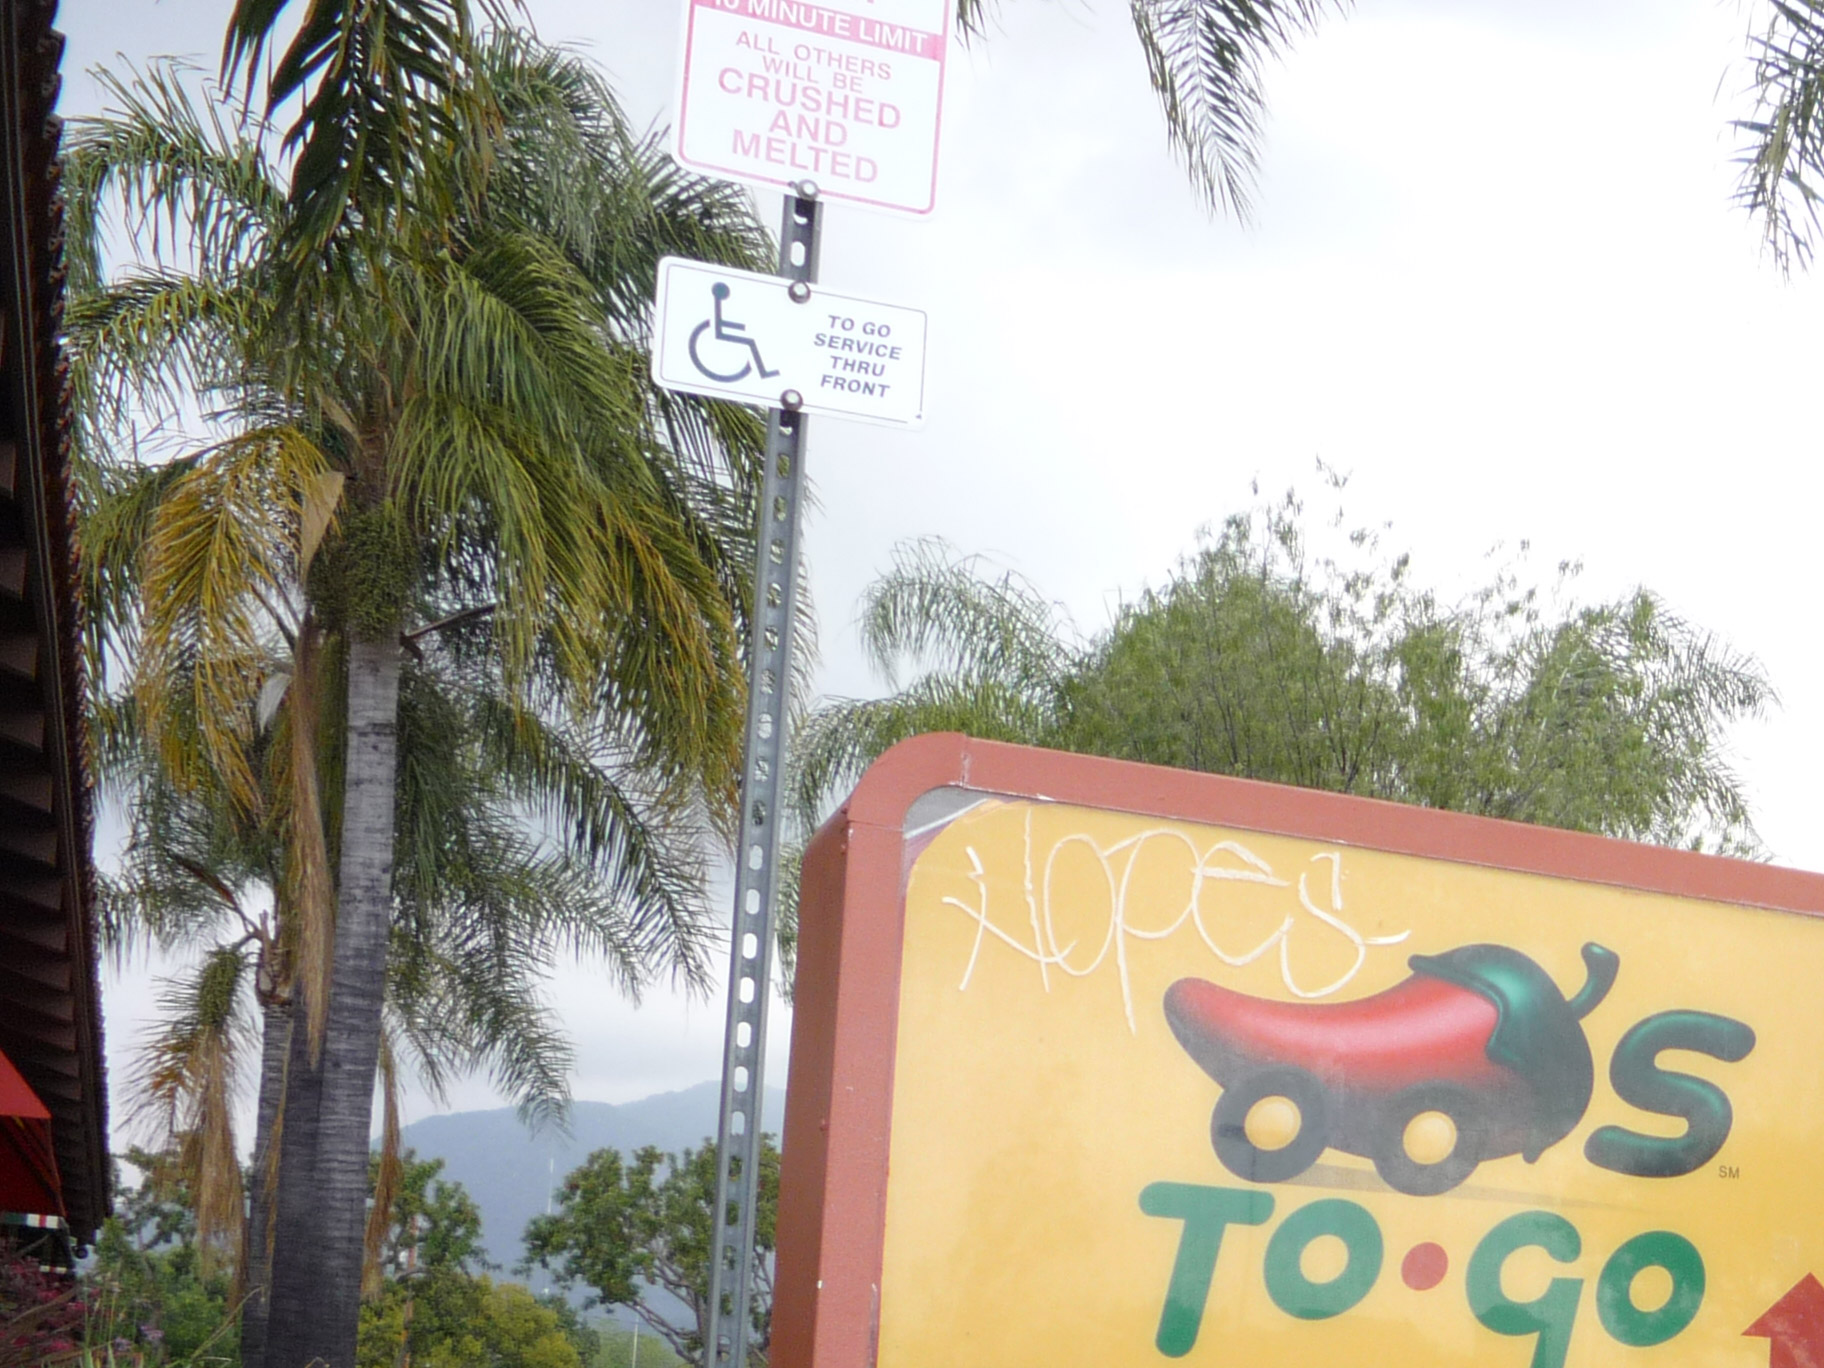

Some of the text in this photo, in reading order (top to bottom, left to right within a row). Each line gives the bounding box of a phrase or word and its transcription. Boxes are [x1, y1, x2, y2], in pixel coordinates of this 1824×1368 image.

[748, 0, 928, 54] MINUTE LIMIT
[735, 30, 892, 81] ALL OTHERS
[762, 54, 863, 94] WILL BE
[718, 67, 901, 129] CRUSHED
[768, 109, 848, 147] AND
[732, 129, 878, 183] MELTED
[828, 314, 891, 338] TO GO
[813, 333, 902, 360] SERVICE
[830, 355, 886, 377] THRU
[820, 374, 890, 398] FRONT
[1719, 1165, 1740, 1179] SM
